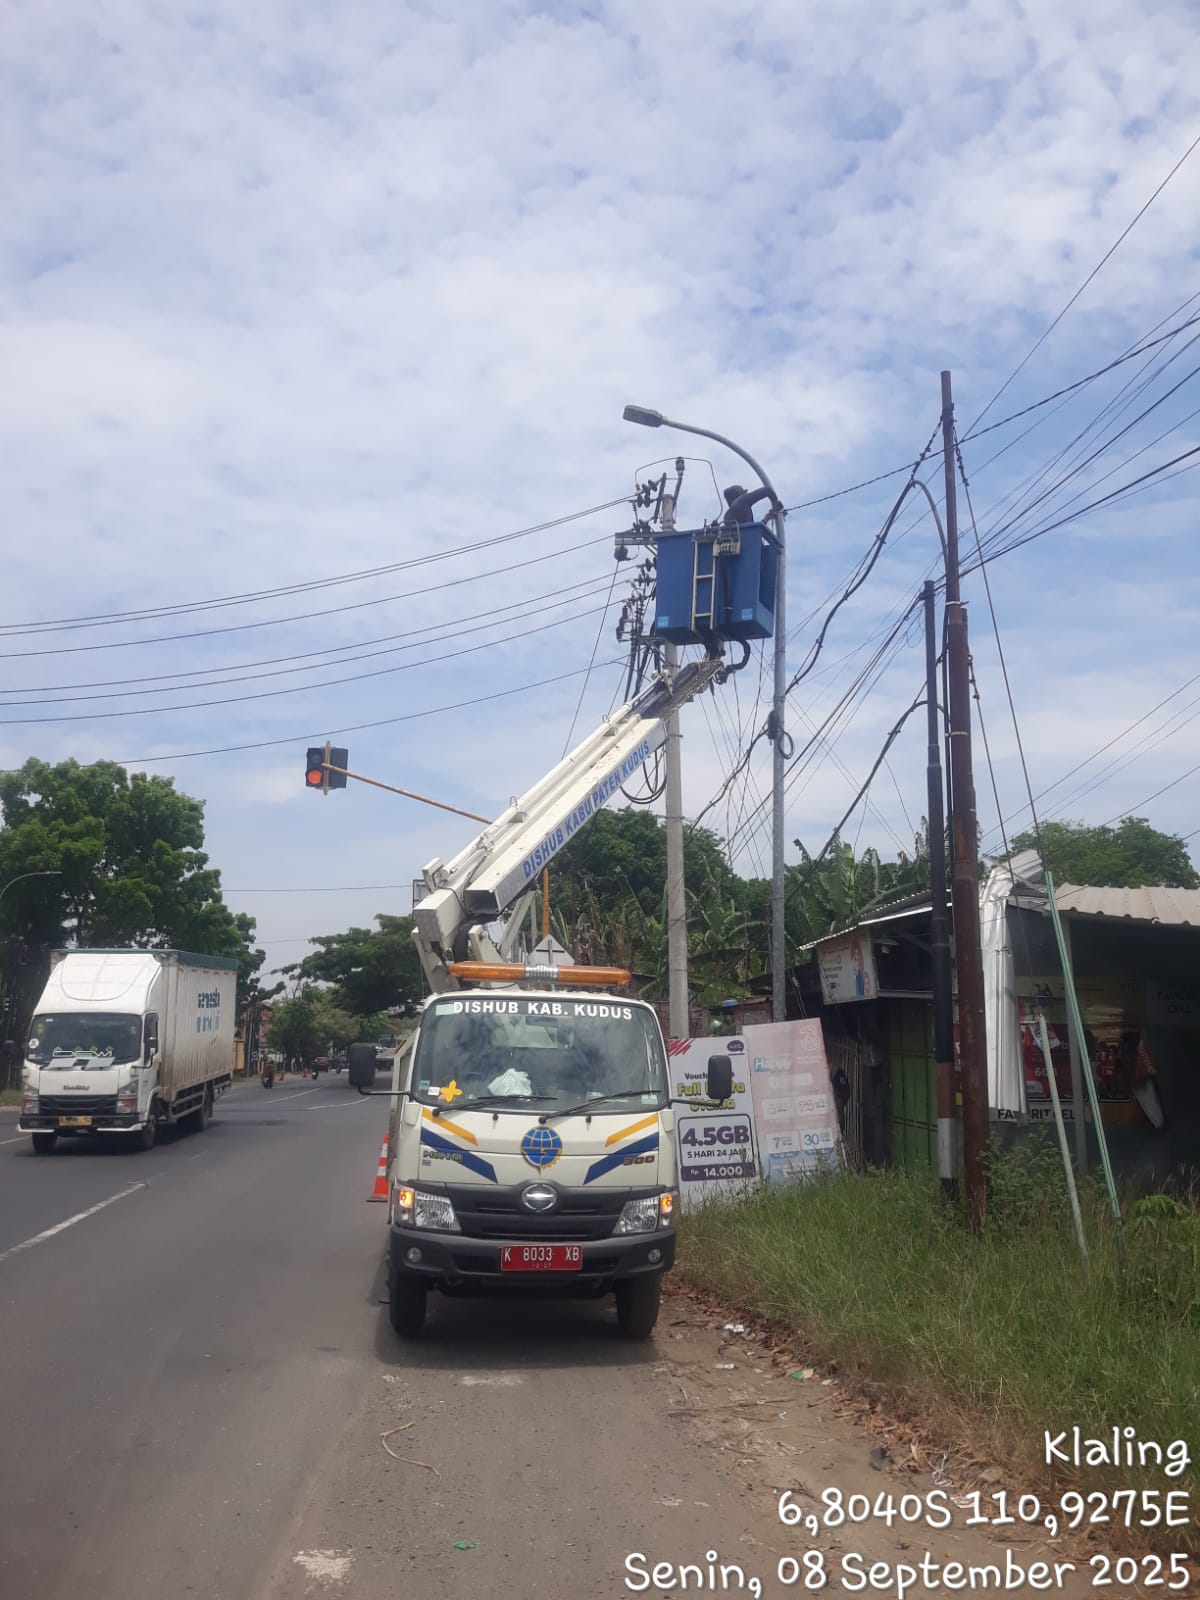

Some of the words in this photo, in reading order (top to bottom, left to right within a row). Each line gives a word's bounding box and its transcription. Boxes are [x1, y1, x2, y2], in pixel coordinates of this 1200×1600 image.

[522, 830, 563, 879] DISHUB
[622, 740, 650, 776] KUDUS
[453, 1001, 519, 1014] DISHUB
[527, 1002, 568, 1016] KAB.
[574, 1003, 632, 1020] KUDUS
[677, 1082, 702, 1097] Full
[682, 1125, 750, 1147] 4.5GB
[804, 1133, 819, 1146] 30
[623, 1154, 655, 1166] 300
[687, 1151, 693, 1159] 5
[694, 1149, 715, 1158] HARI
[716, 1149, 727, 1157] 24
[703, 1166, 743, 1177] 14.000
[504, 1247, 511, 1262] K
[523, 1247, 553, 1262] 8033
[565, 1247, 579, 1262] XB
